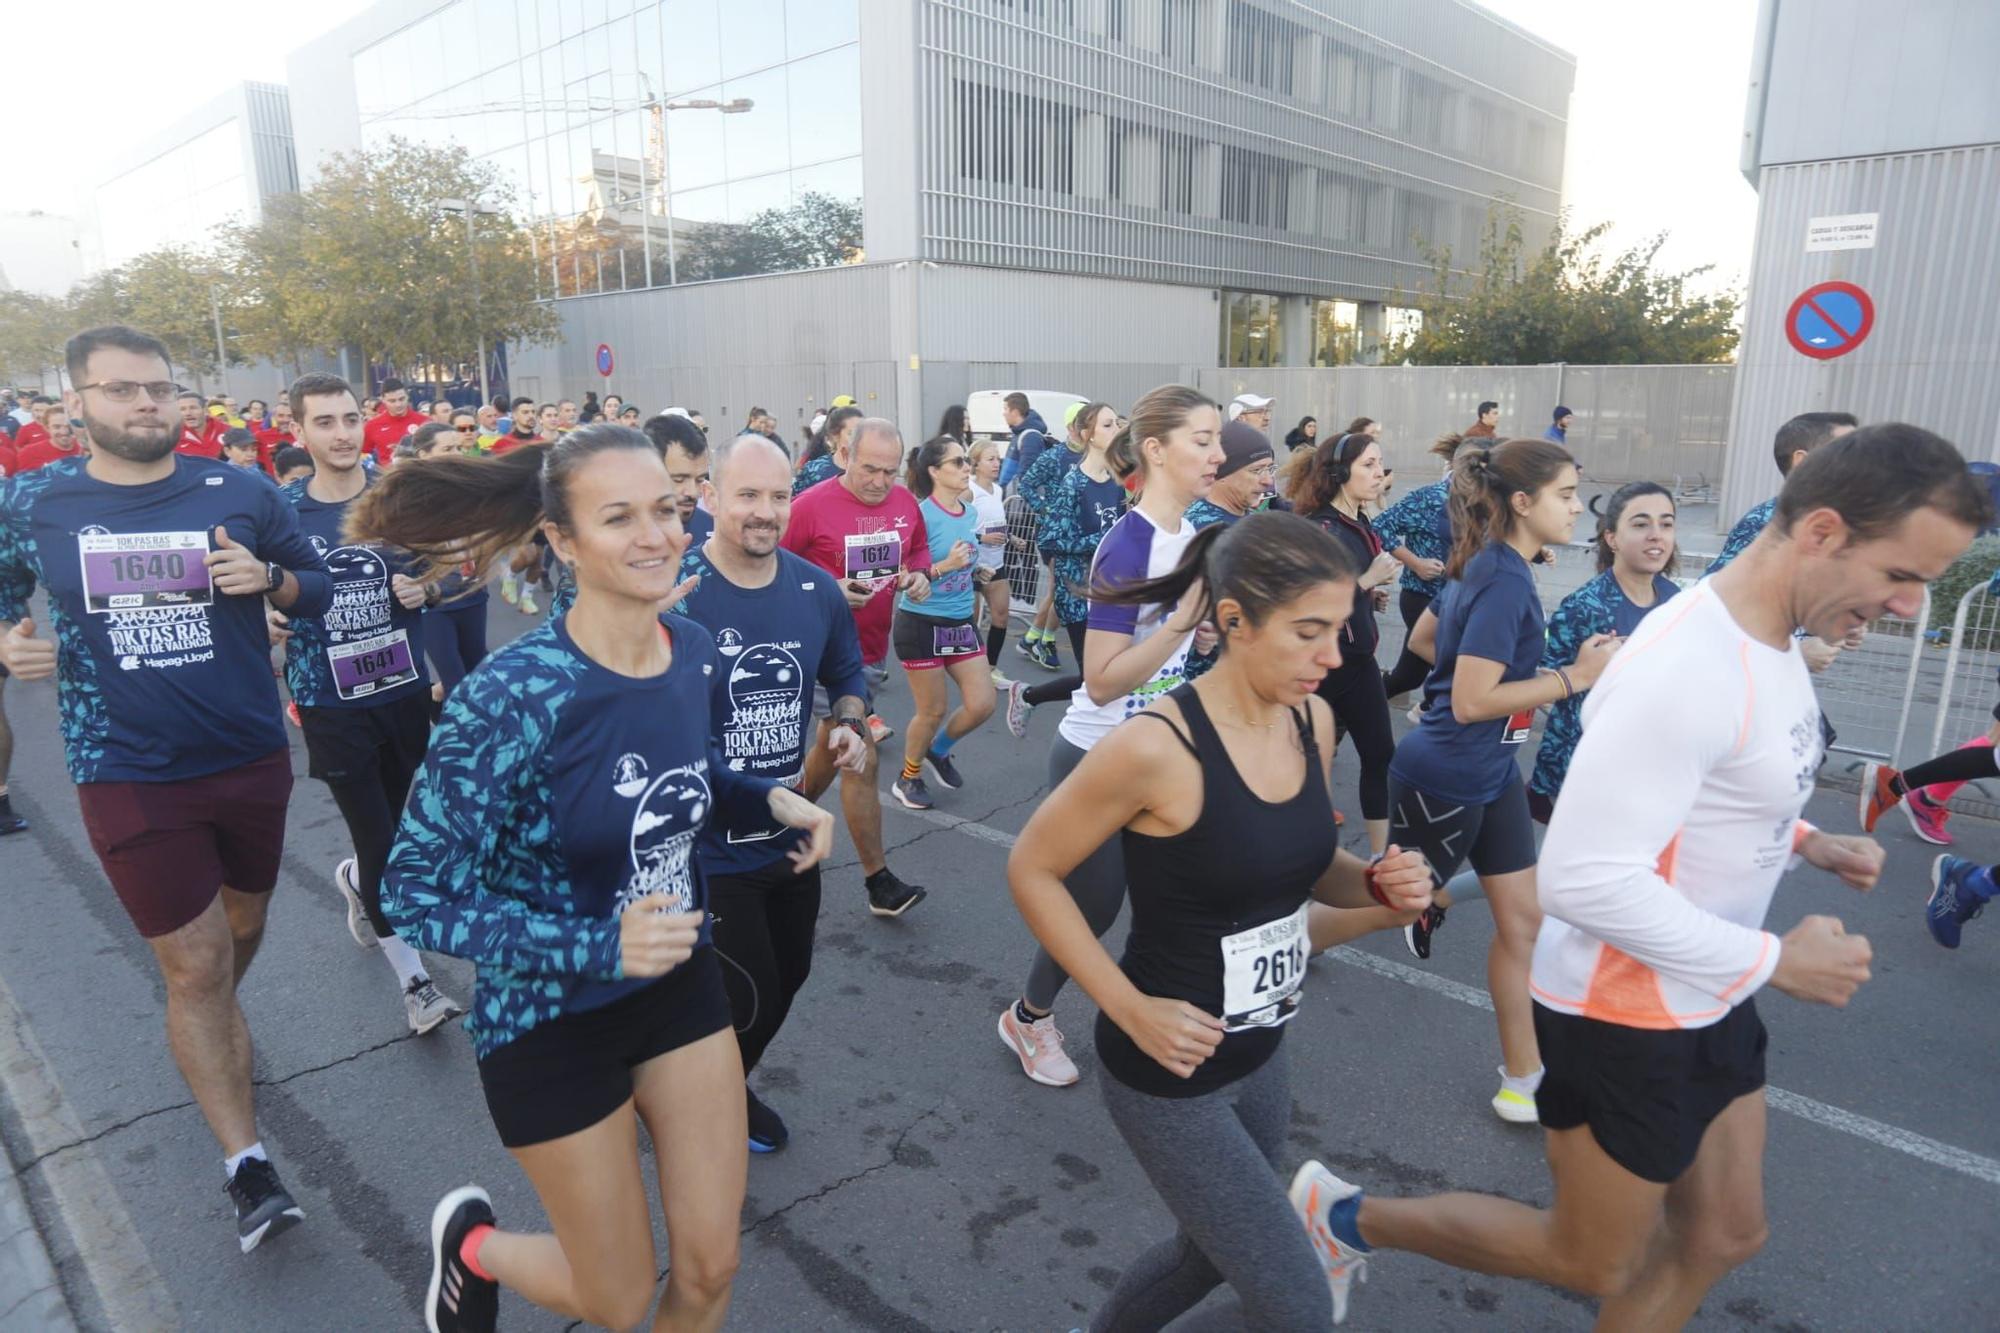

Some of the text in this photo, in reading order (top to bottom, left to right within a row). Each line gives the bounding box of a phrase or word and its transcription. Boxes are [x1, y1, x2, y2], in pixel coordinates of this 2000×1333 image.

[117, 537, 133, 546] 10K
[134, 537, 151, 546] PAS
[152, 536, 170, 545] RAS
[861, 545, 890, 563] 1612
[111, 553, 185, 582] 1640
[324, 604, 391, 625] 10K PAS RAS
[107, 621, 211, 646] 10K PAS RAS
[113, 645, 125, 656] AL
[150, 642, 166, 654] DE
[165, 636, 213, 652] VALENCIA
[144, 650, 214, 668] Hapag-Lloyd
[352, 648, 395, 676] 1641
[723, 724, 800, 749] 10K PAS RAS
[725, 739, 800, 757] AL PORT DE VALENCIA
[752, 751, 799, 769] Hapag-Lloyd
